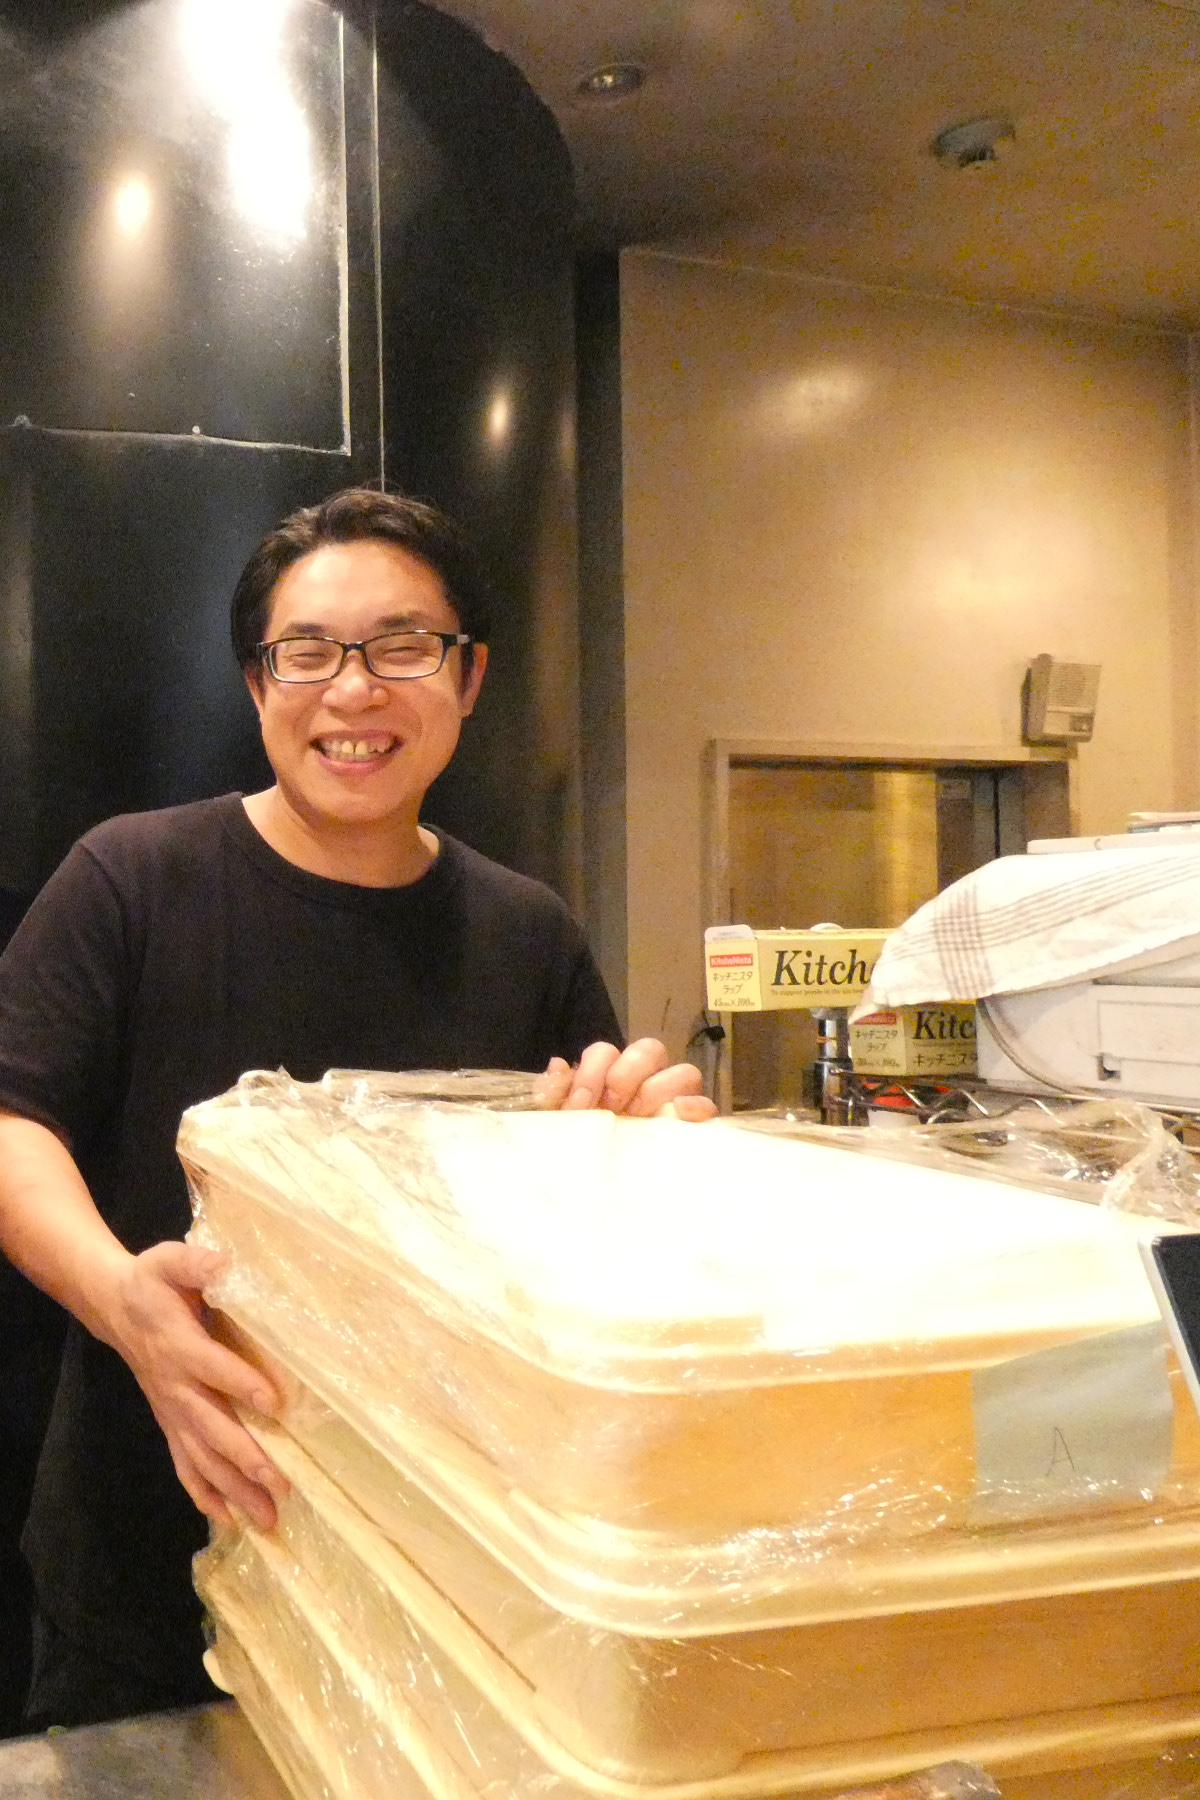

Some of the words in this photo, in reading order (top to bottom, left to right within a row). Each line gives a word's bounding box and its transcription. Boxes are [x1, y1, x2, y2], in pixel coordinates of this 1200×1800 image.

[712, 971, 753, 981] キッチニスタ
[771, 949, 876, 986] Kitch
[723, 984, 743, 995] ラップ
[912, 1011, 976, 1039] Kitc
[1045, 1426, 1075, 1477] A
